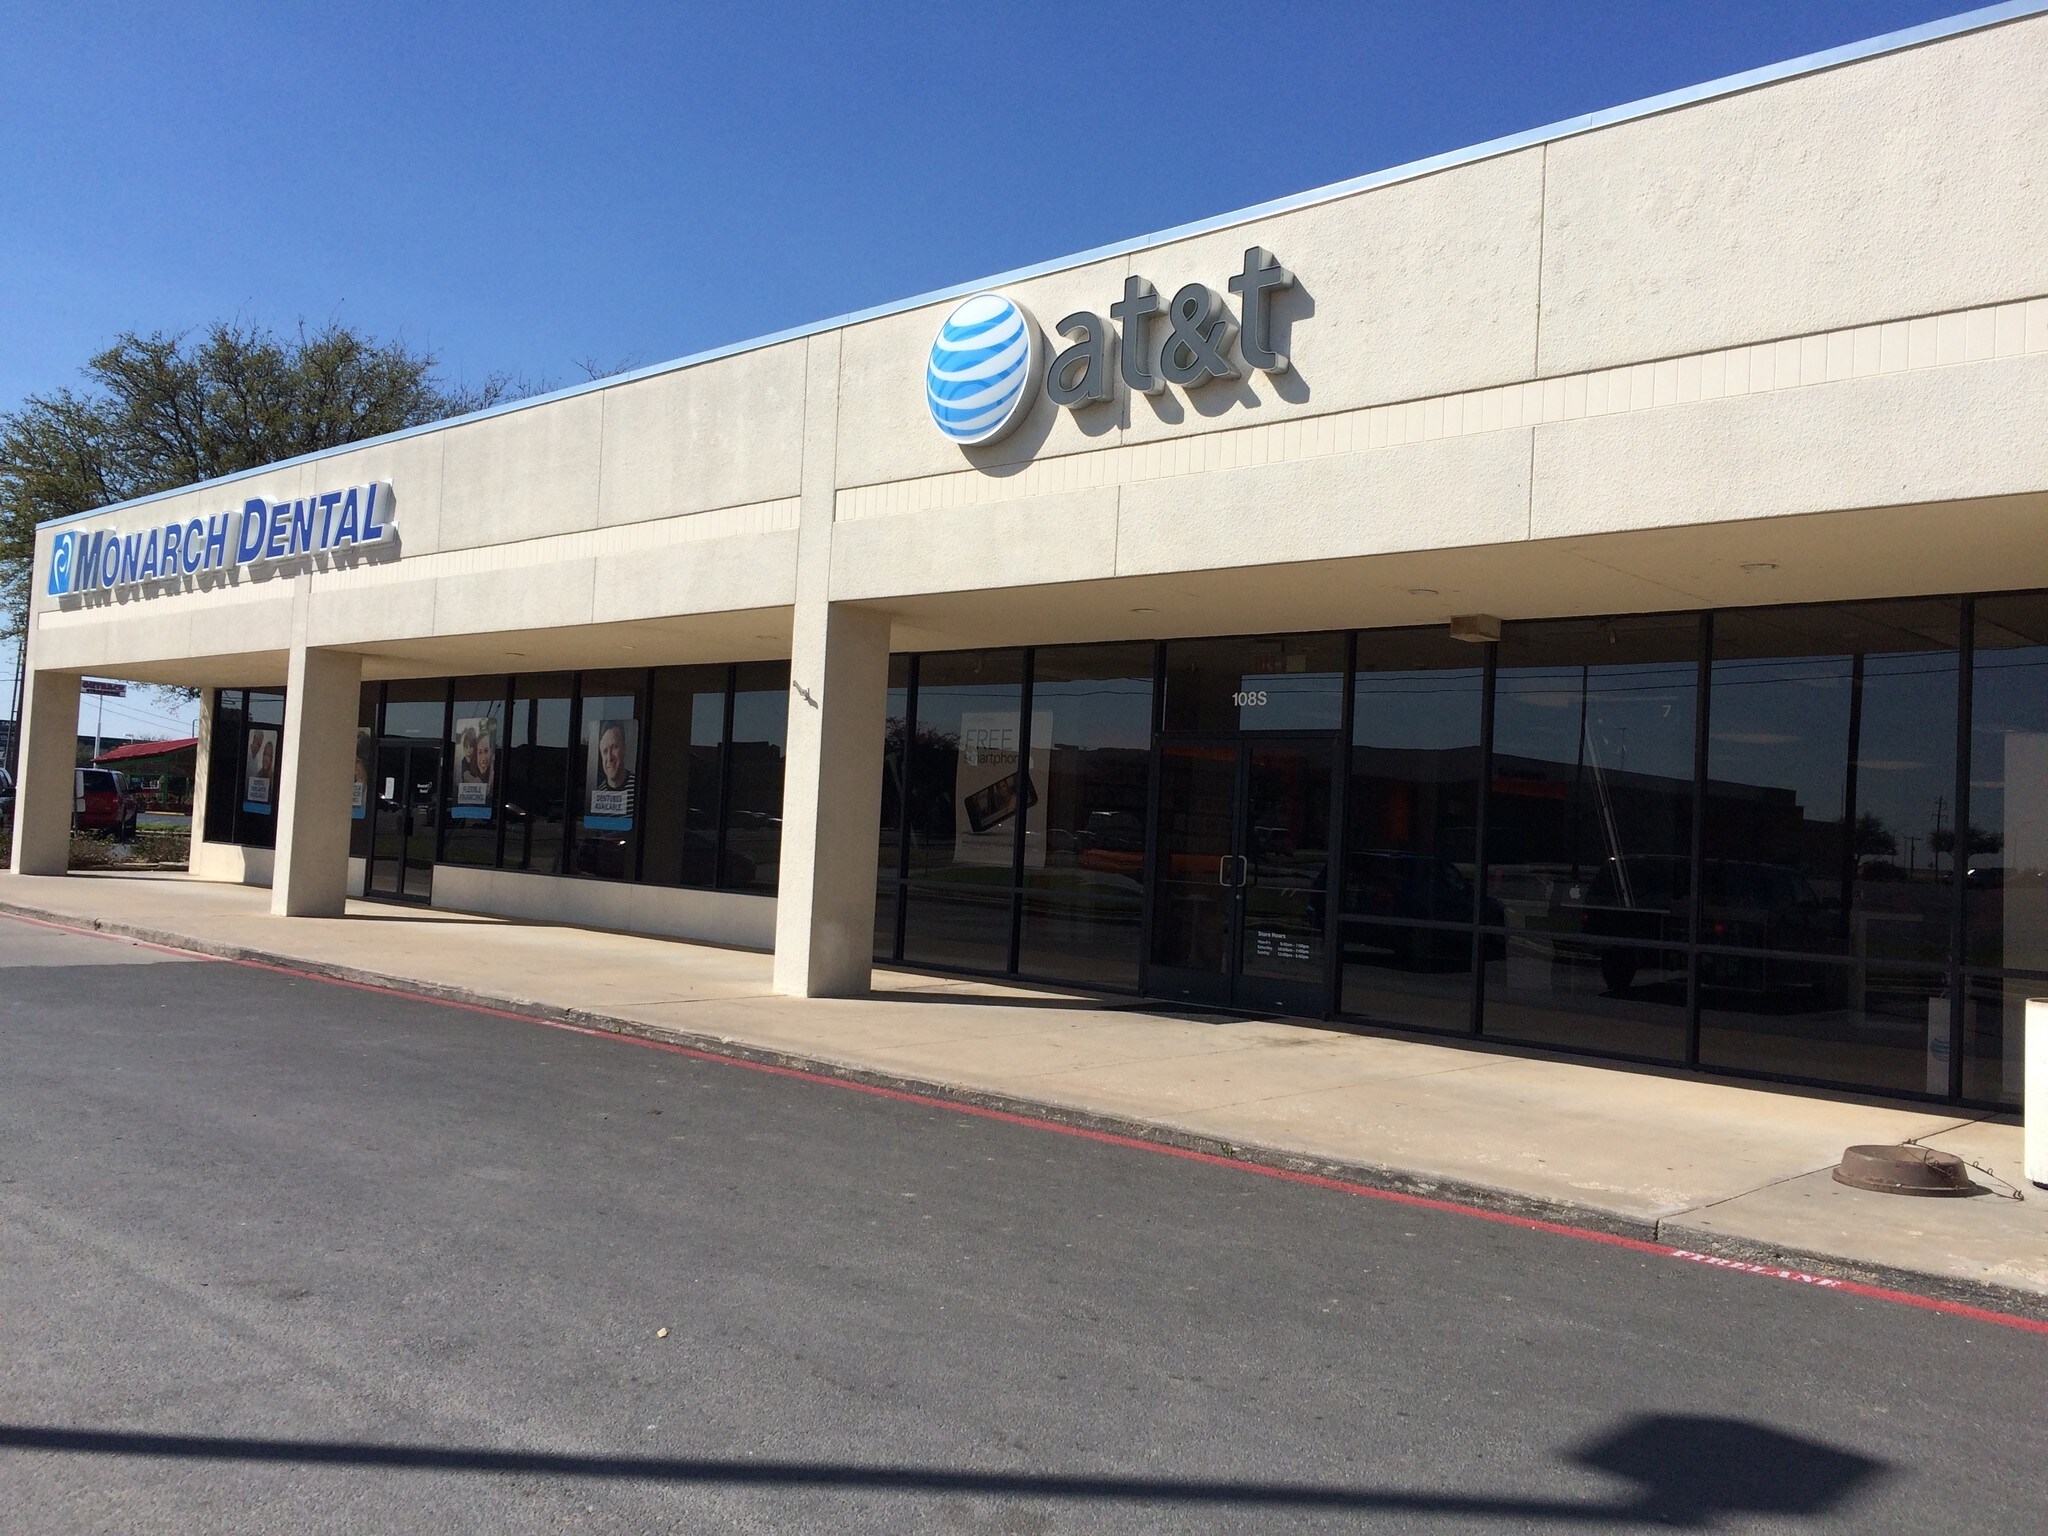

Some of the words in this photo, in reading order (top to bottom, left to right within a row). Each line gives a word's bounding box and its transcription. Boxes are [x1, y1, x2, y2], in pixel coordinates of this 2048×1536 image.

[1046, 245, 1283, 406] at&t
[75, 511, 231, 593] MONARCH
[236, 483, 385, 565] DENTAL
[1232, 691, 1268, 707] 108S
[966, 729, 1013, 750] FREE
[596, 794, 623, 802] DENTURES
[1257, 930, 1271, 938] Store
